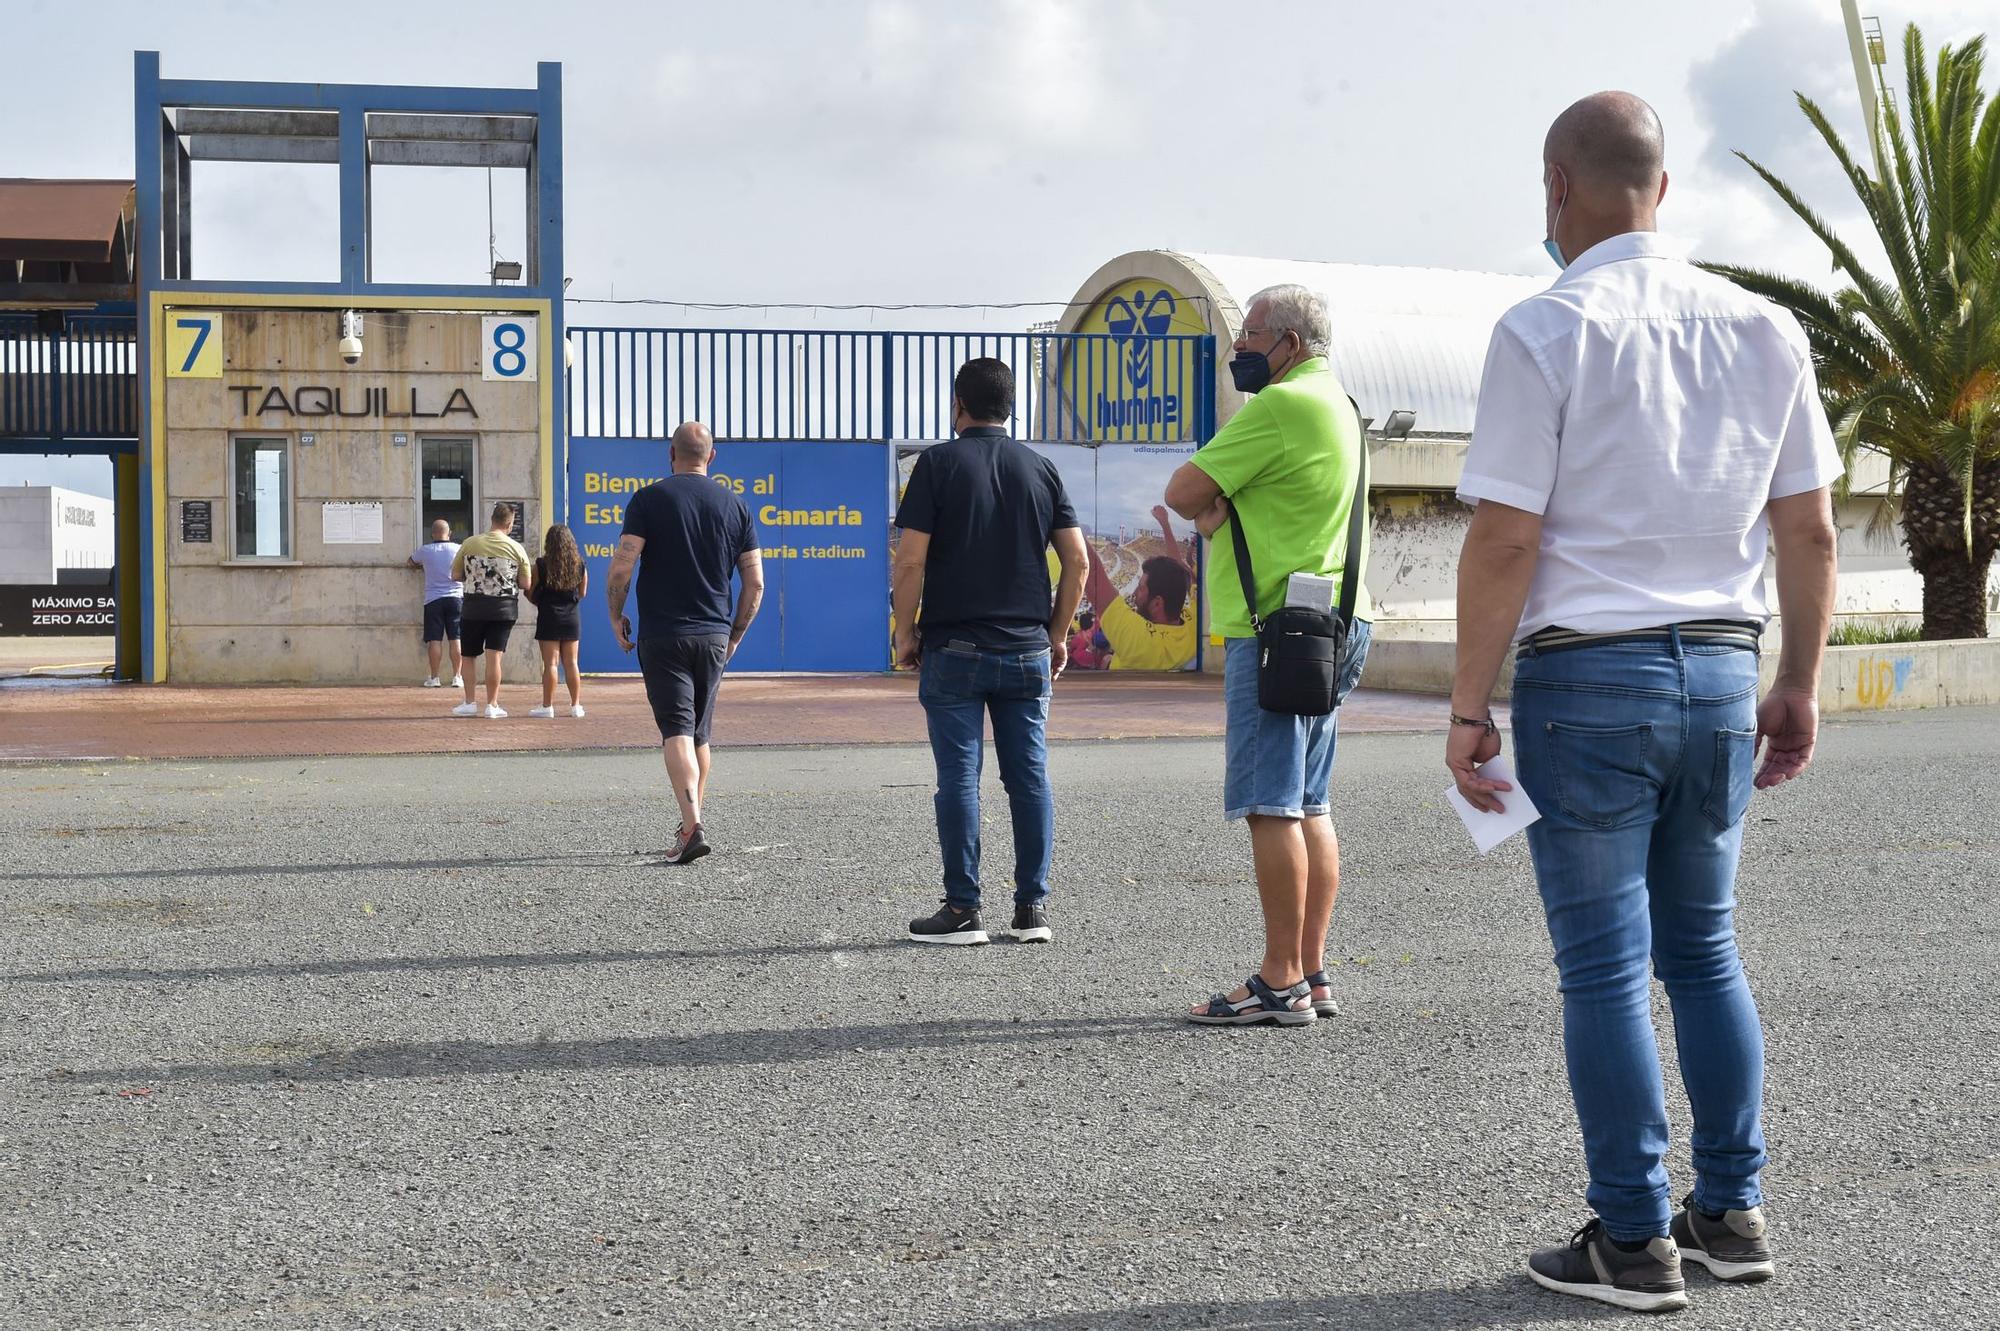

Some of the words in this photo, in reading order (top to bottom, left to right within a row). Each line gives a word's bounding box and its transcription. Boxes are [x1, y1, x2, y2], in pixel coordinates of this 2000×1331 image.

[176, 319, 212, 372] 7
[492, 322, 527, 377] 8
[228, 385, 479, 419] TAQUILLA
[1133, 445, 1195, 454] udlaspalmas.es
[753, 473, 774, 495] al
[759, 504, 862, 526] Canaria
[584, 543, 617, 558] Wel
[802, 545, 865, 559] stadium
[31, 596, 93, 609] MÁXIMO
[32, 613, 72, 625] ZERO
